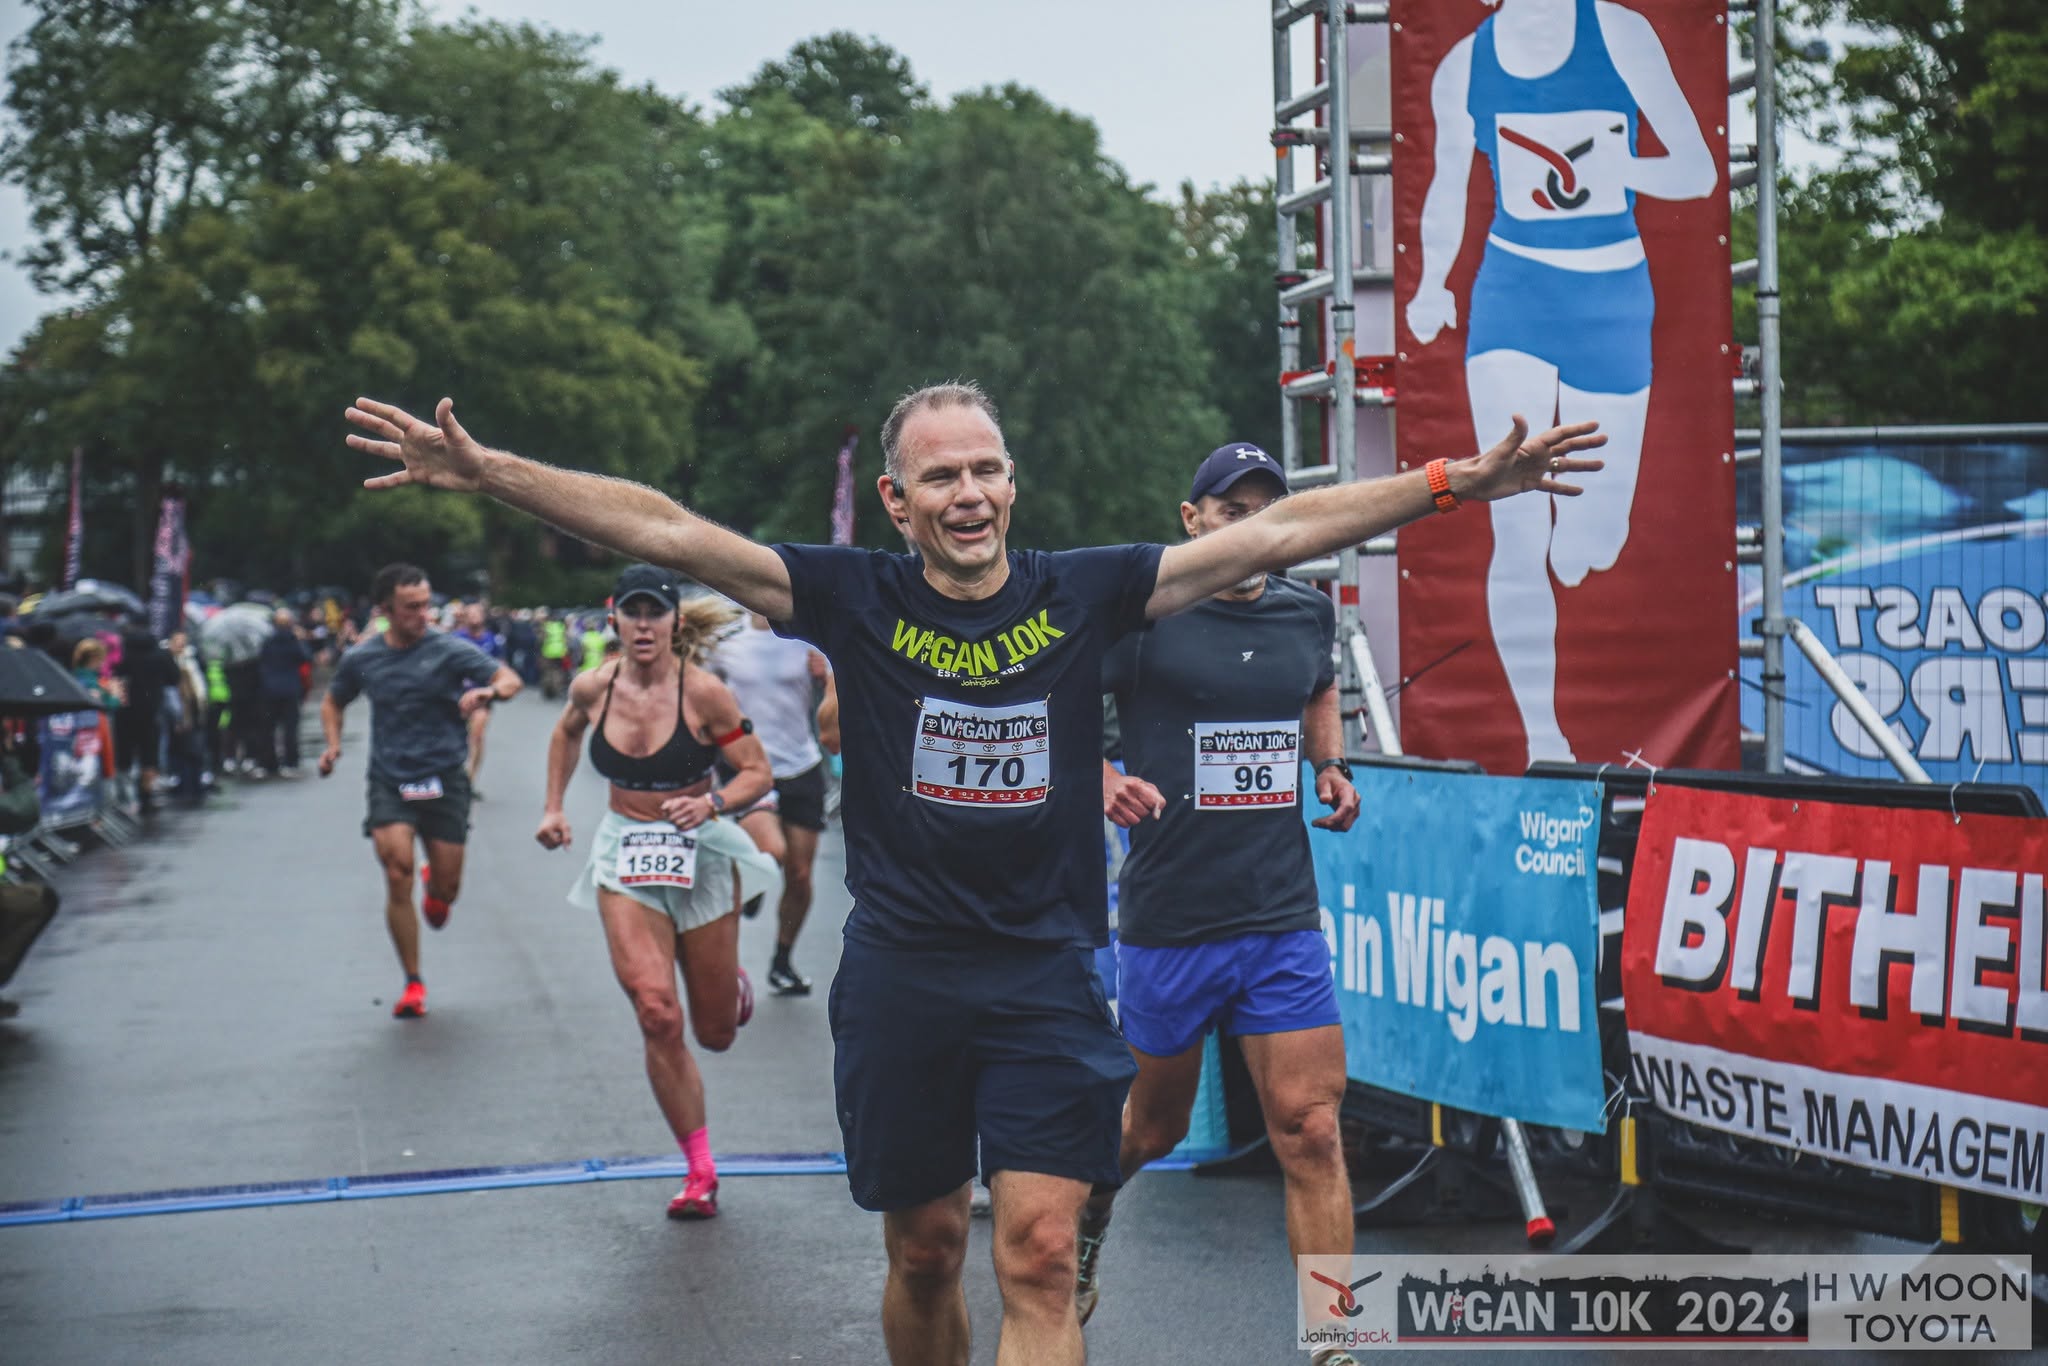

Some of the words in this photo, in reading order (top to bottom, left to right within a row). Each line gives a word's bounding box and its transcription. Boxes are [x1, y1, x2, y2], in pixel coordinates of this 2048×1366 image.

[997, 608, 1066, 666] 10K
[1005, 719, 1034, 740] 10K
[1265, 734, 1287, 750] 10K
[947, 756, 1025, 788] 170
[1234, 765, 1273, 792] 96
[1520, 812, 1581, 848] Wigan
[627, 855, 685, 874] 1582
[1516, 845, 1585, 877] Council
[1344, 884, 1383, 997] in
[1388, 892, 1580, 1042] Wigan
[1632, 1053, 1793, 1138] WASTE
[1803, 1088, 2046, 1195] MANAGEM
